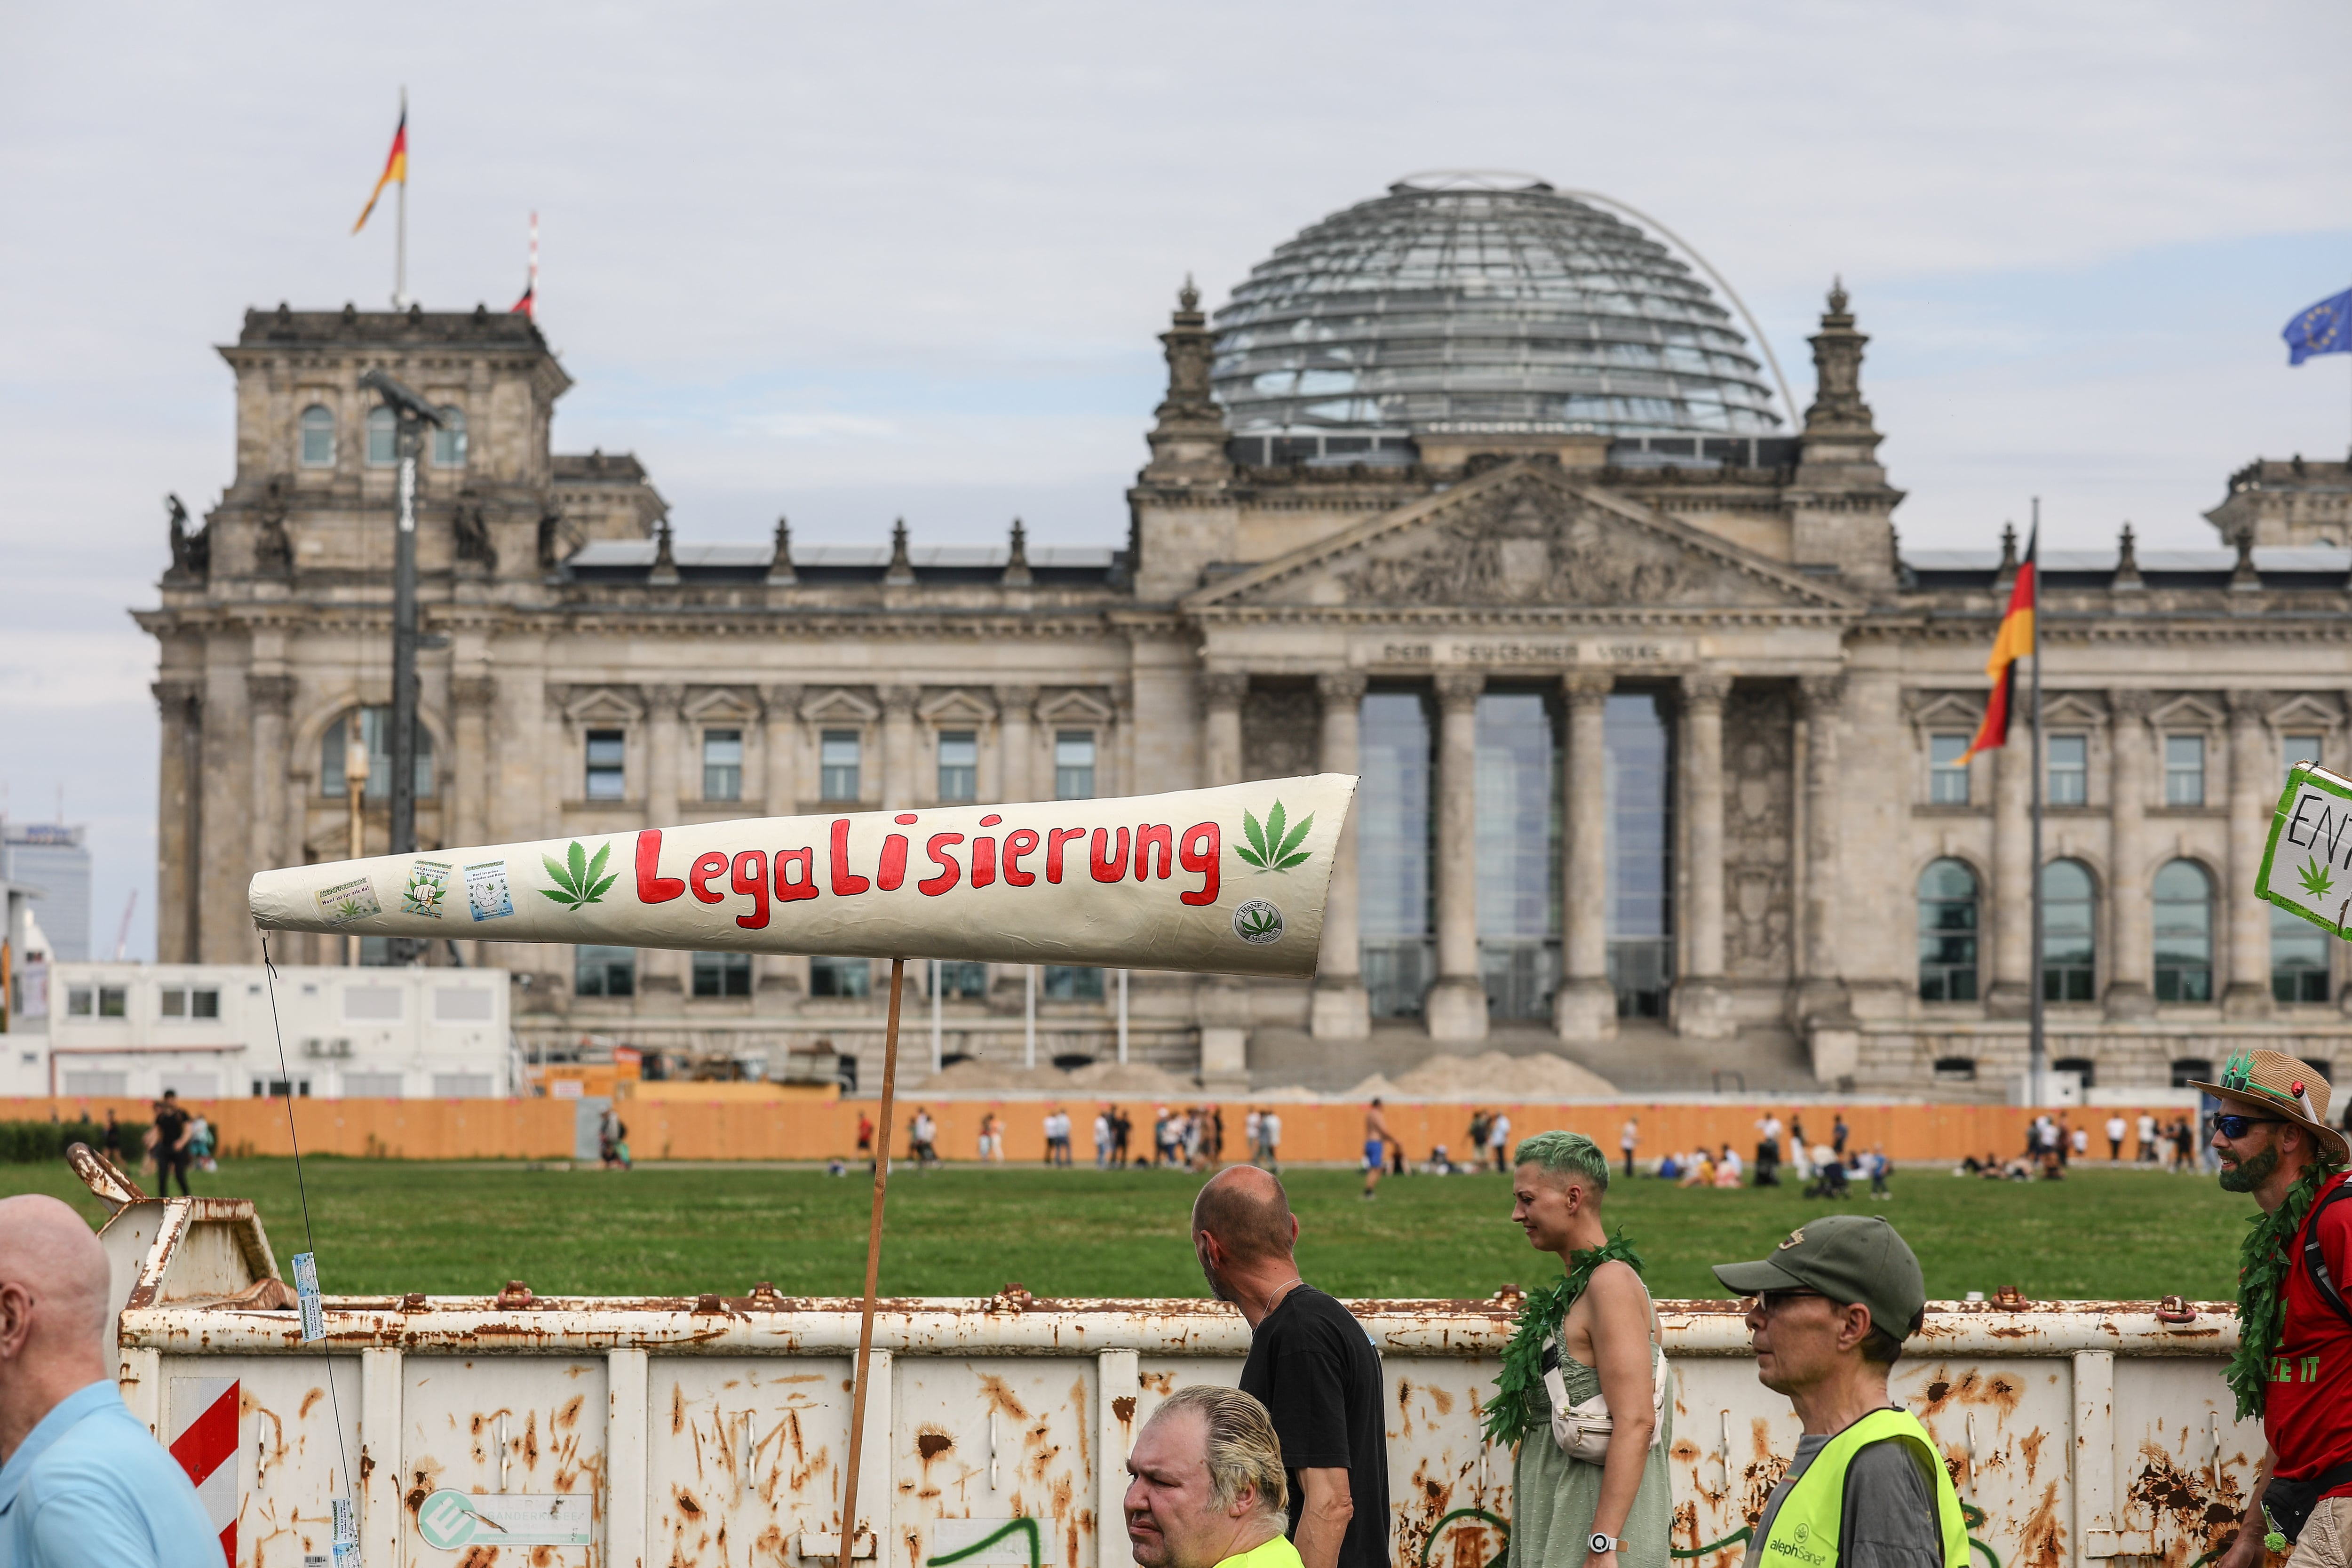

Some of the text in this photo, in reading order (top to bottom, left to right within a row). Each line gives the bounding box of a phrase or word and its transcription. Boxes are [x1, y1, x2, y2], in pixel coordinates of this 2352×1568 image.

[414, 866, 448, 875] LEGALISIERUNG
[319, 877, 367, 898] HANFPARADE
[1240, 903, 1263, 914] HANF
[1251, 929, 1279, 941] MUSEUM
[2300, 1356, 2320, 1382] IT
